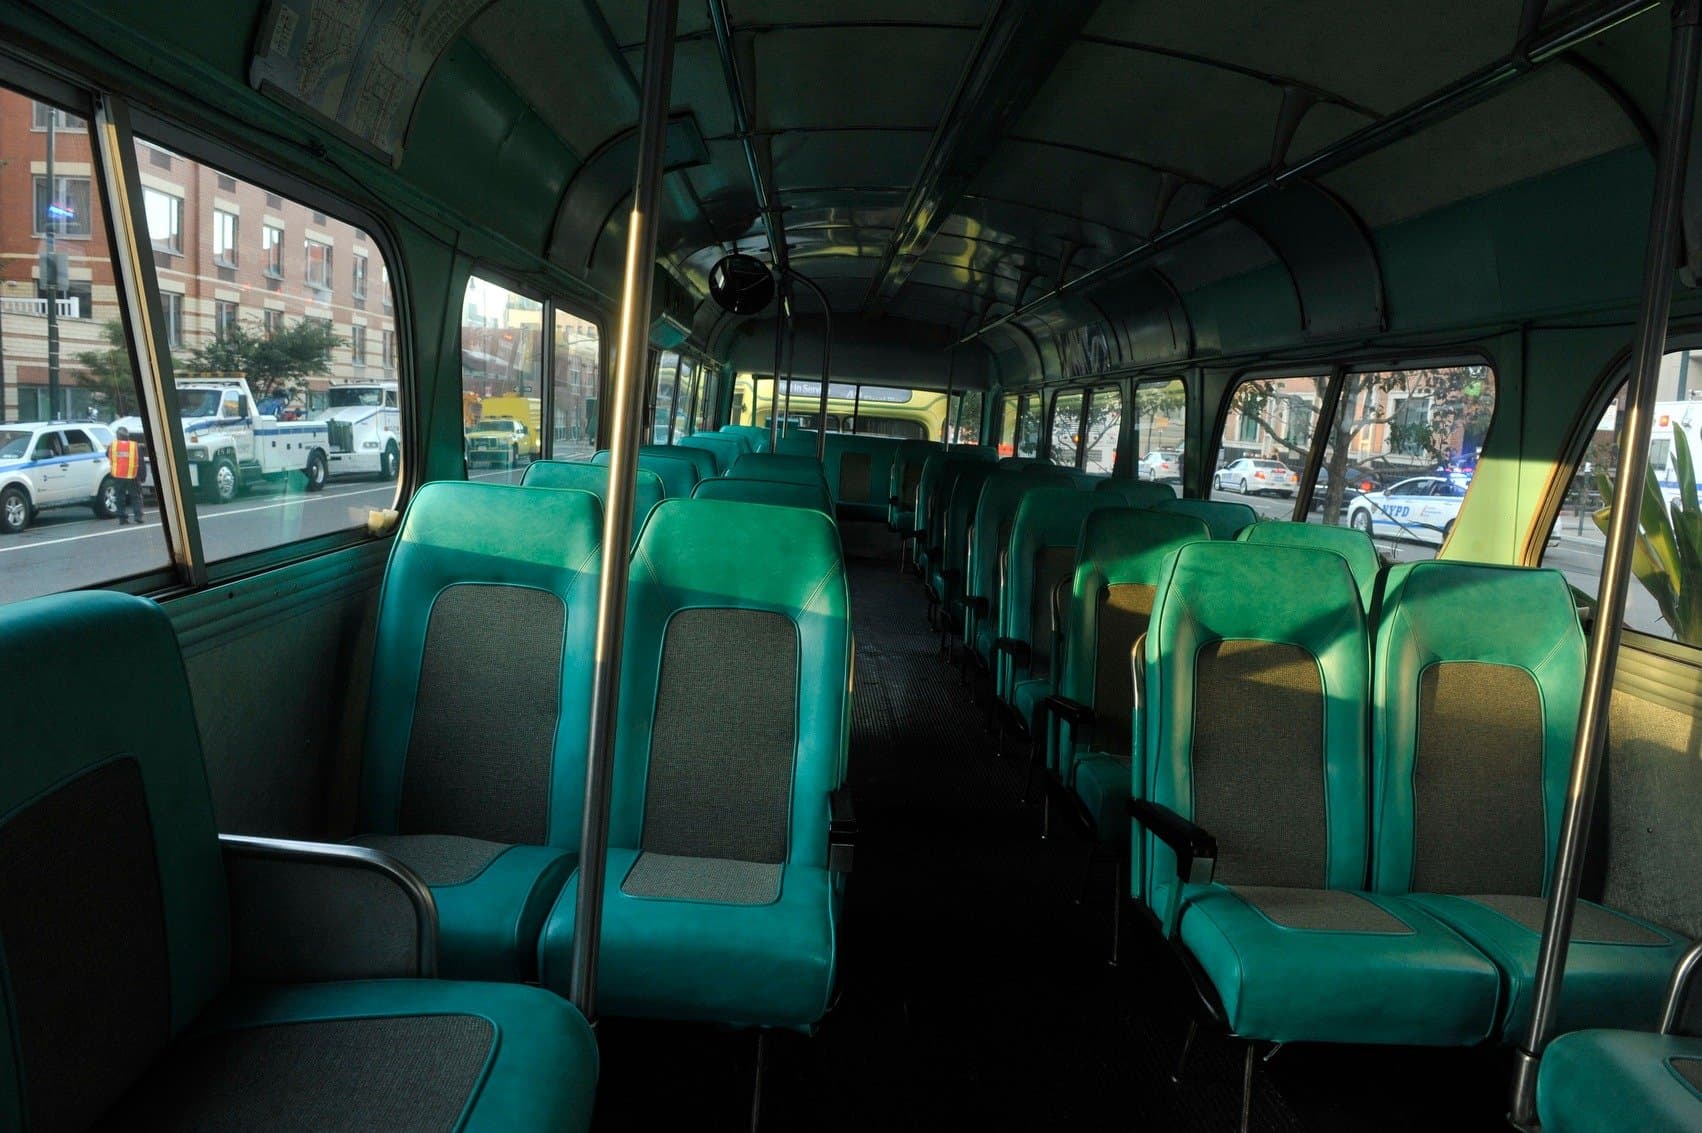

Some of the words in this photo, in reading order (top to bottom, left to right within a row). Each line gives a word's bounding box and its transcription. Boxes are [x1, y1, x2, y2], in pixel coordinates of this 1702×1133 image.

[779, 382, 793, 393] Nt
[802, 384, 831, 395] Serv
[1382, 504, 1410, 517] NYPD
